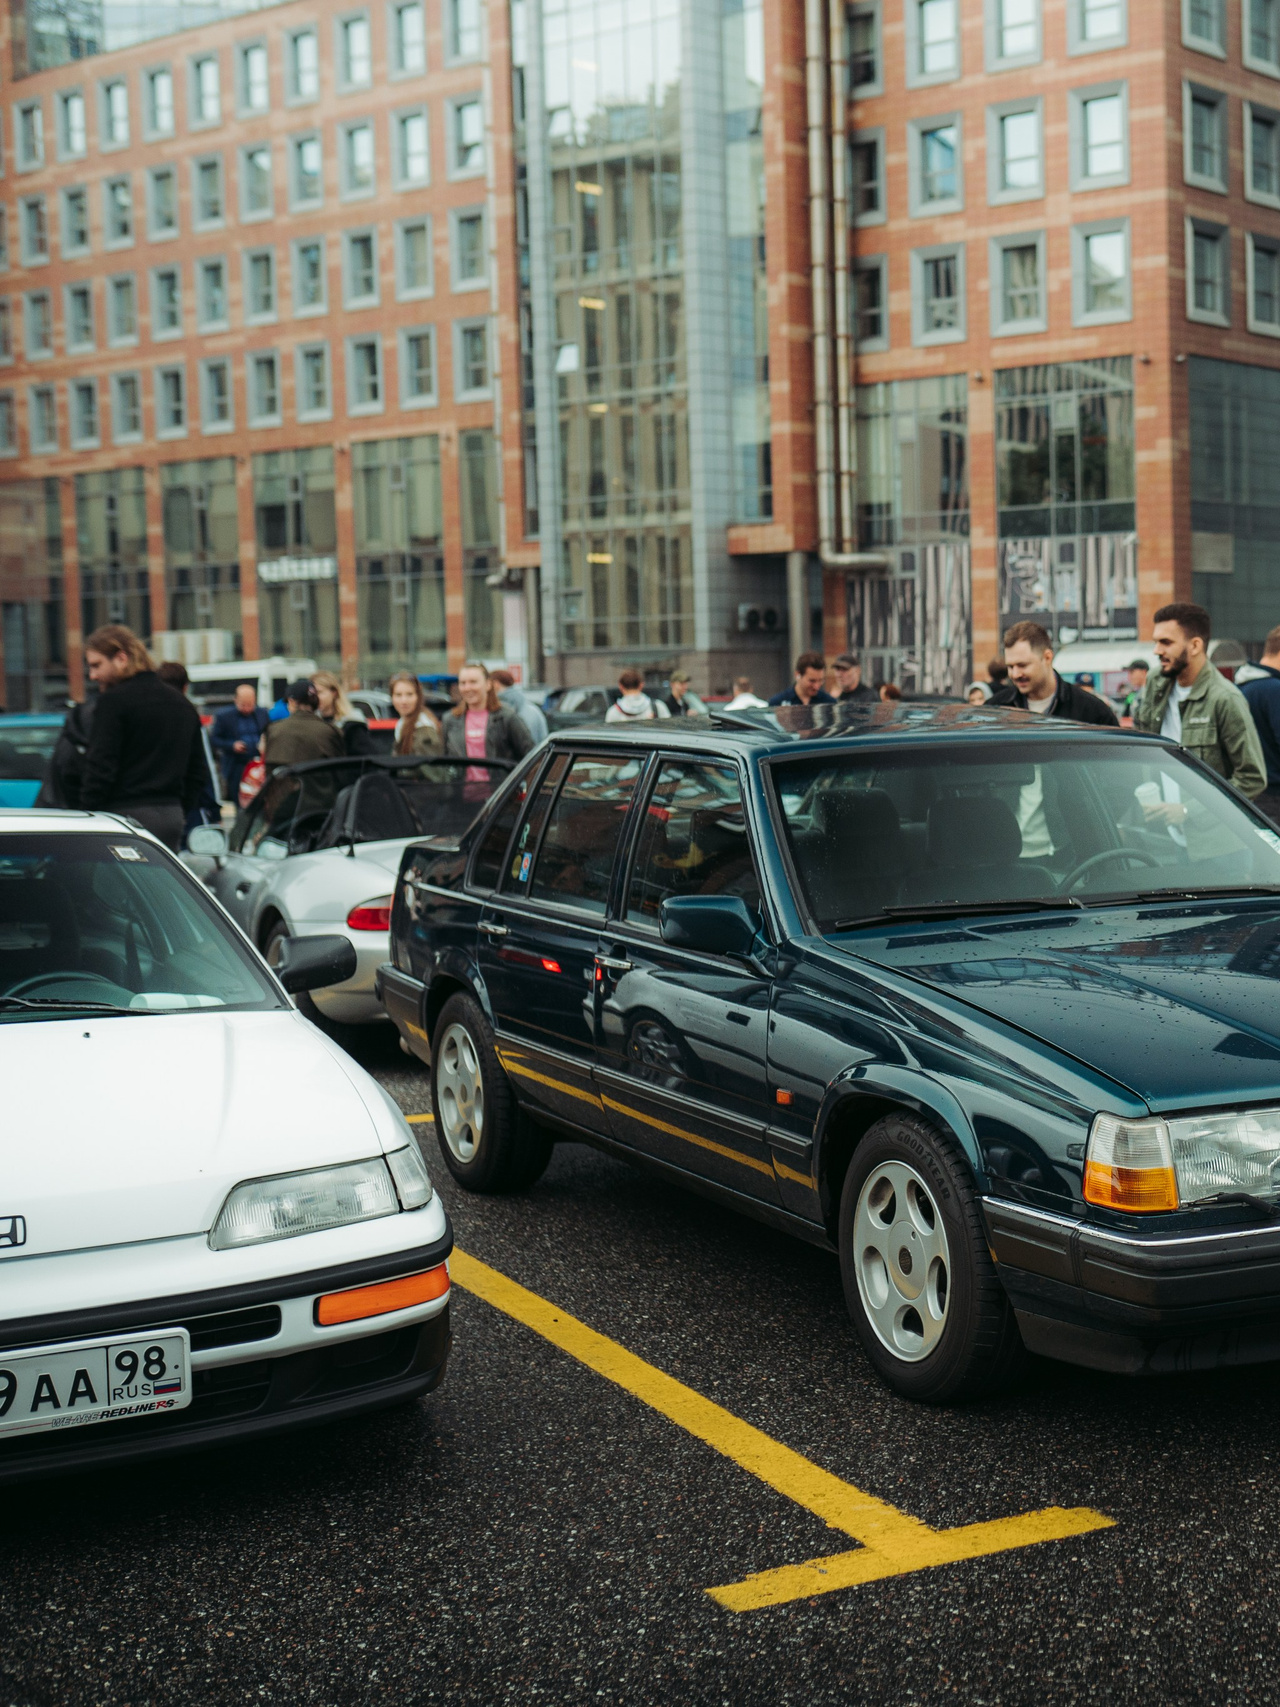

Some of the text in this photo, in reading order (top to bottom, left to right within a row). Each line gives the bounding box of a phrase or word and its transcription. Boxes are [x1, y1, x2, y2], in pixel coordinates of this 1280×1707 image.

[896, 1130, 951, 1200] GOODYEAR
[115, 1345, 167, 1386] 98
[113, 1384, 152, 1401] RUS
[51, 1398, 176, 1428] WE ARE REDLINERS
